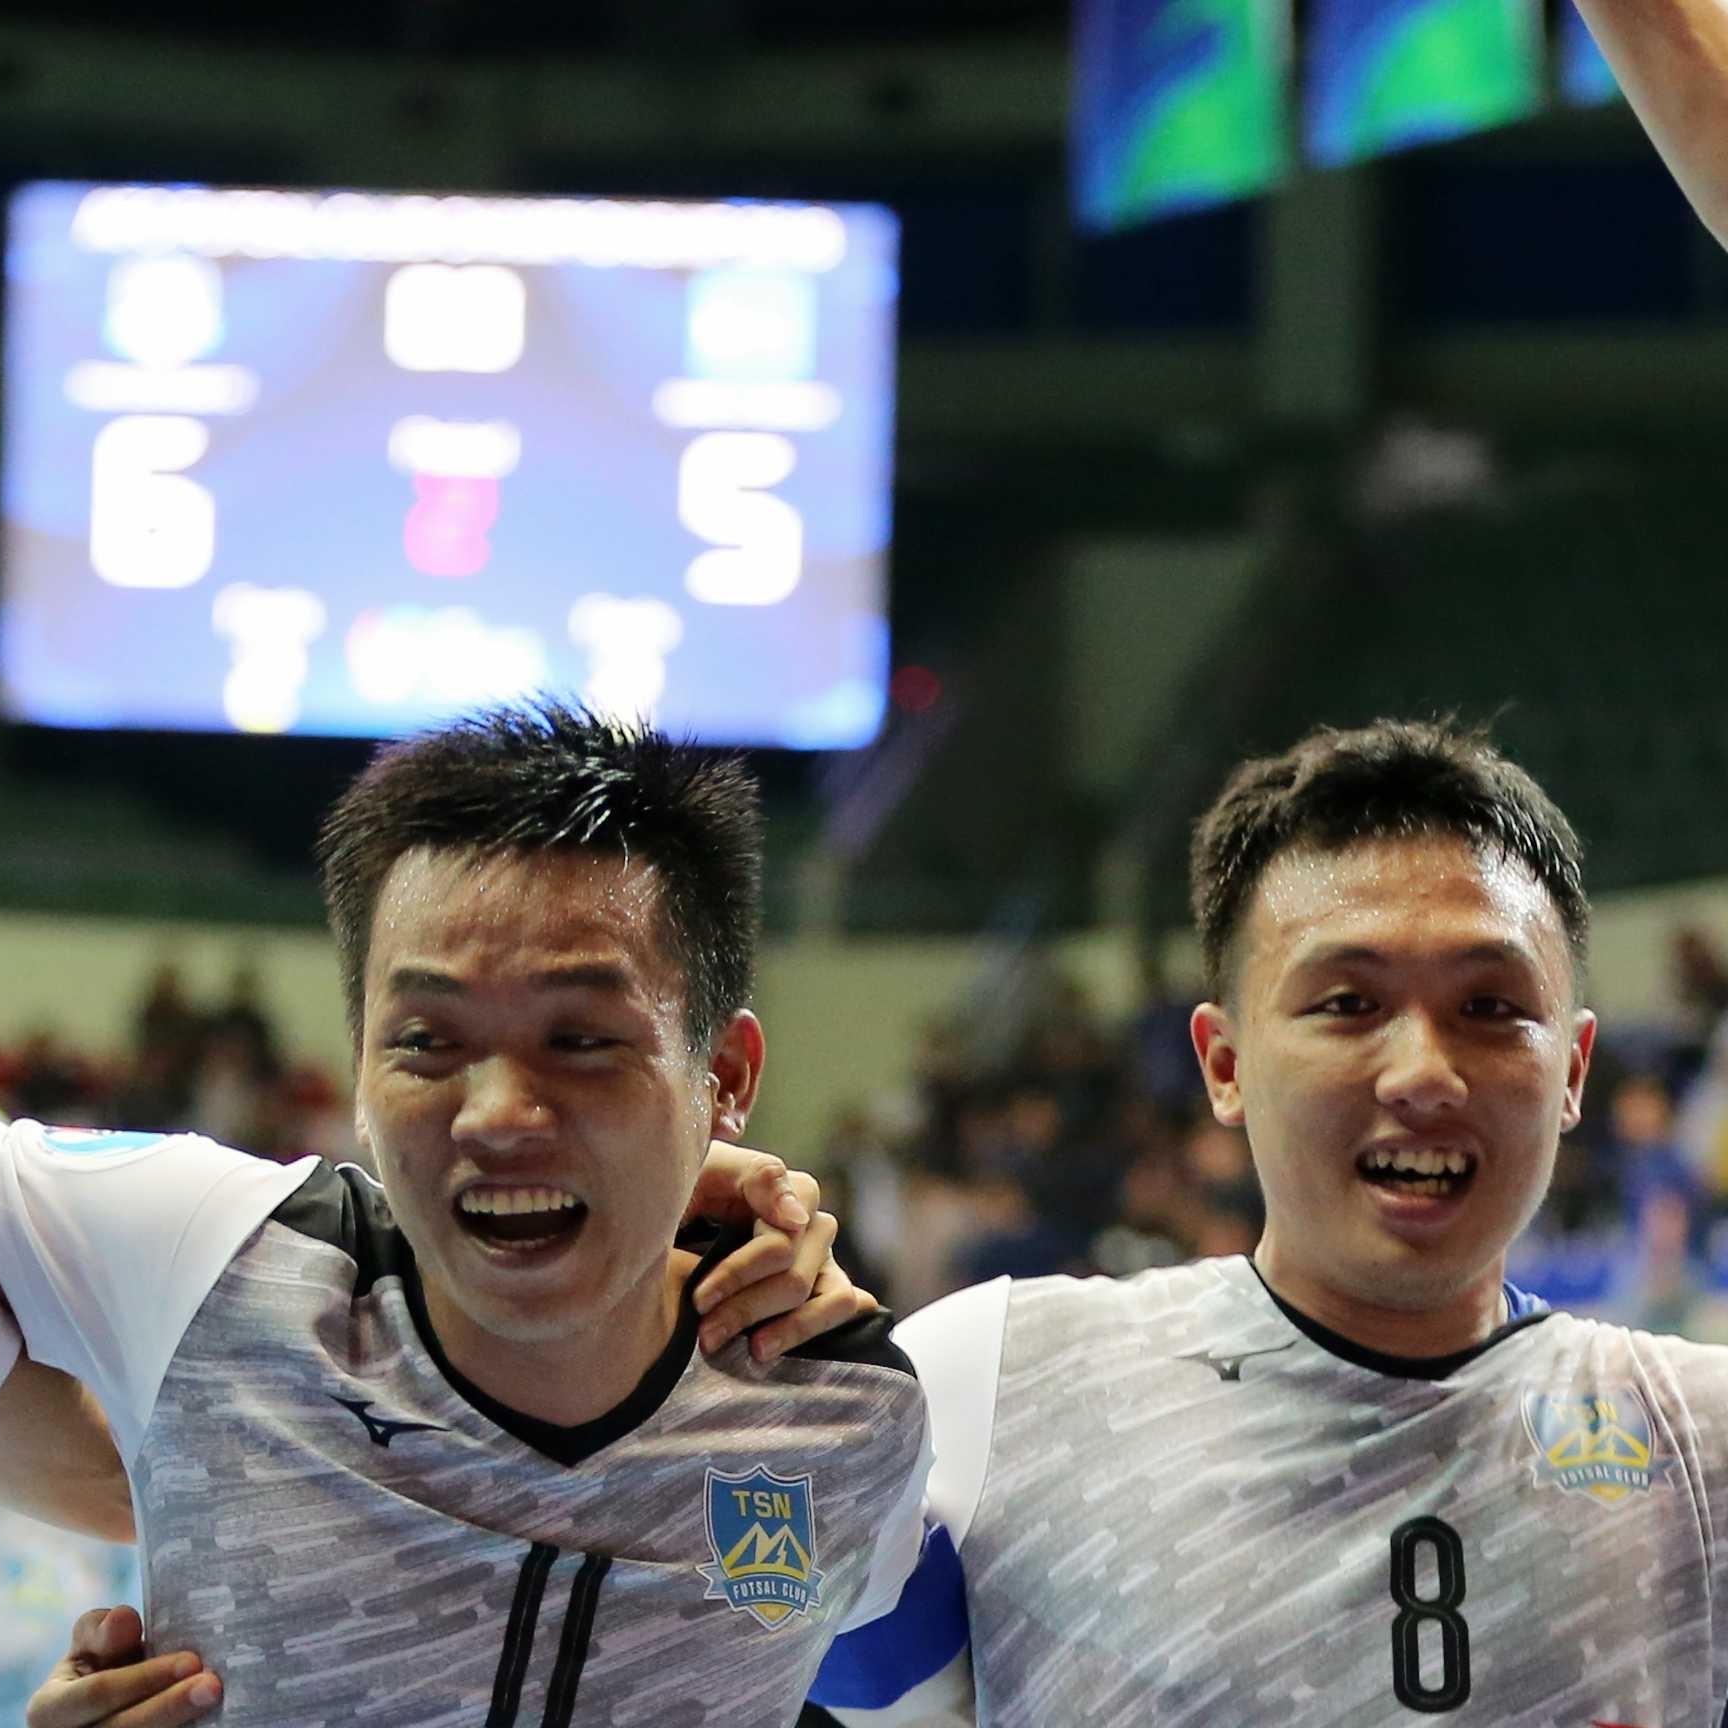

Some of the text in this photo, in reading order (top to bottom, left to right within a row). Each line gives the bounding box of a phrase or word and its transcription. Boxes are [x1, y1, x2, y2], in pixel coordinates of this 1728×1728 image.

[731, 1490, 793, 1520] TSN
[732, 1580, 807, 1604] FUTSAL CLUB
[1389, 1514, 1471, 1714] 8
